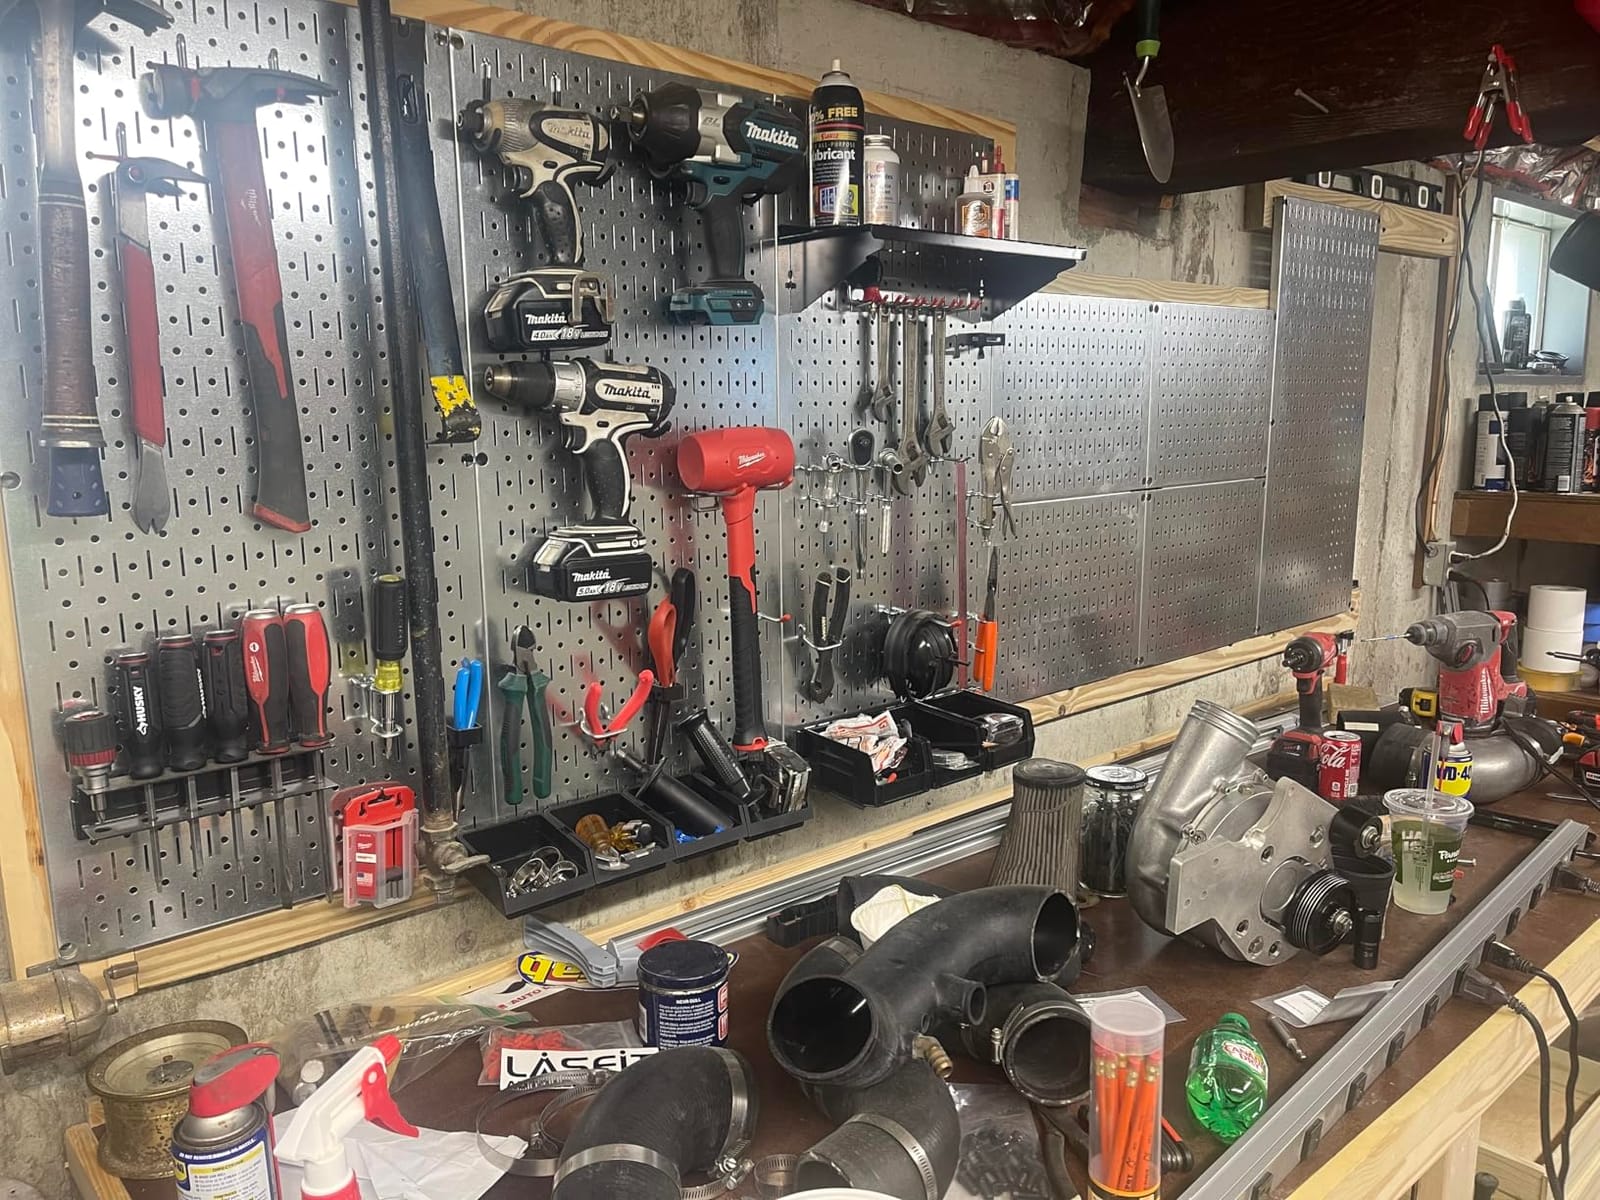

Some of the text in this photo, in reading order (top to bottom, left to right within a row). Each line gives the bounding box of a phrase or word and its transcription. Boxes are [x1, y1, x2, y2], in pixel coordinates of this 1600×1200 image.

[827, 106, 858, 118] FREE
[133, 686, 147, 722] HUSKY
[510, 989, 542, 1005] AUTO
